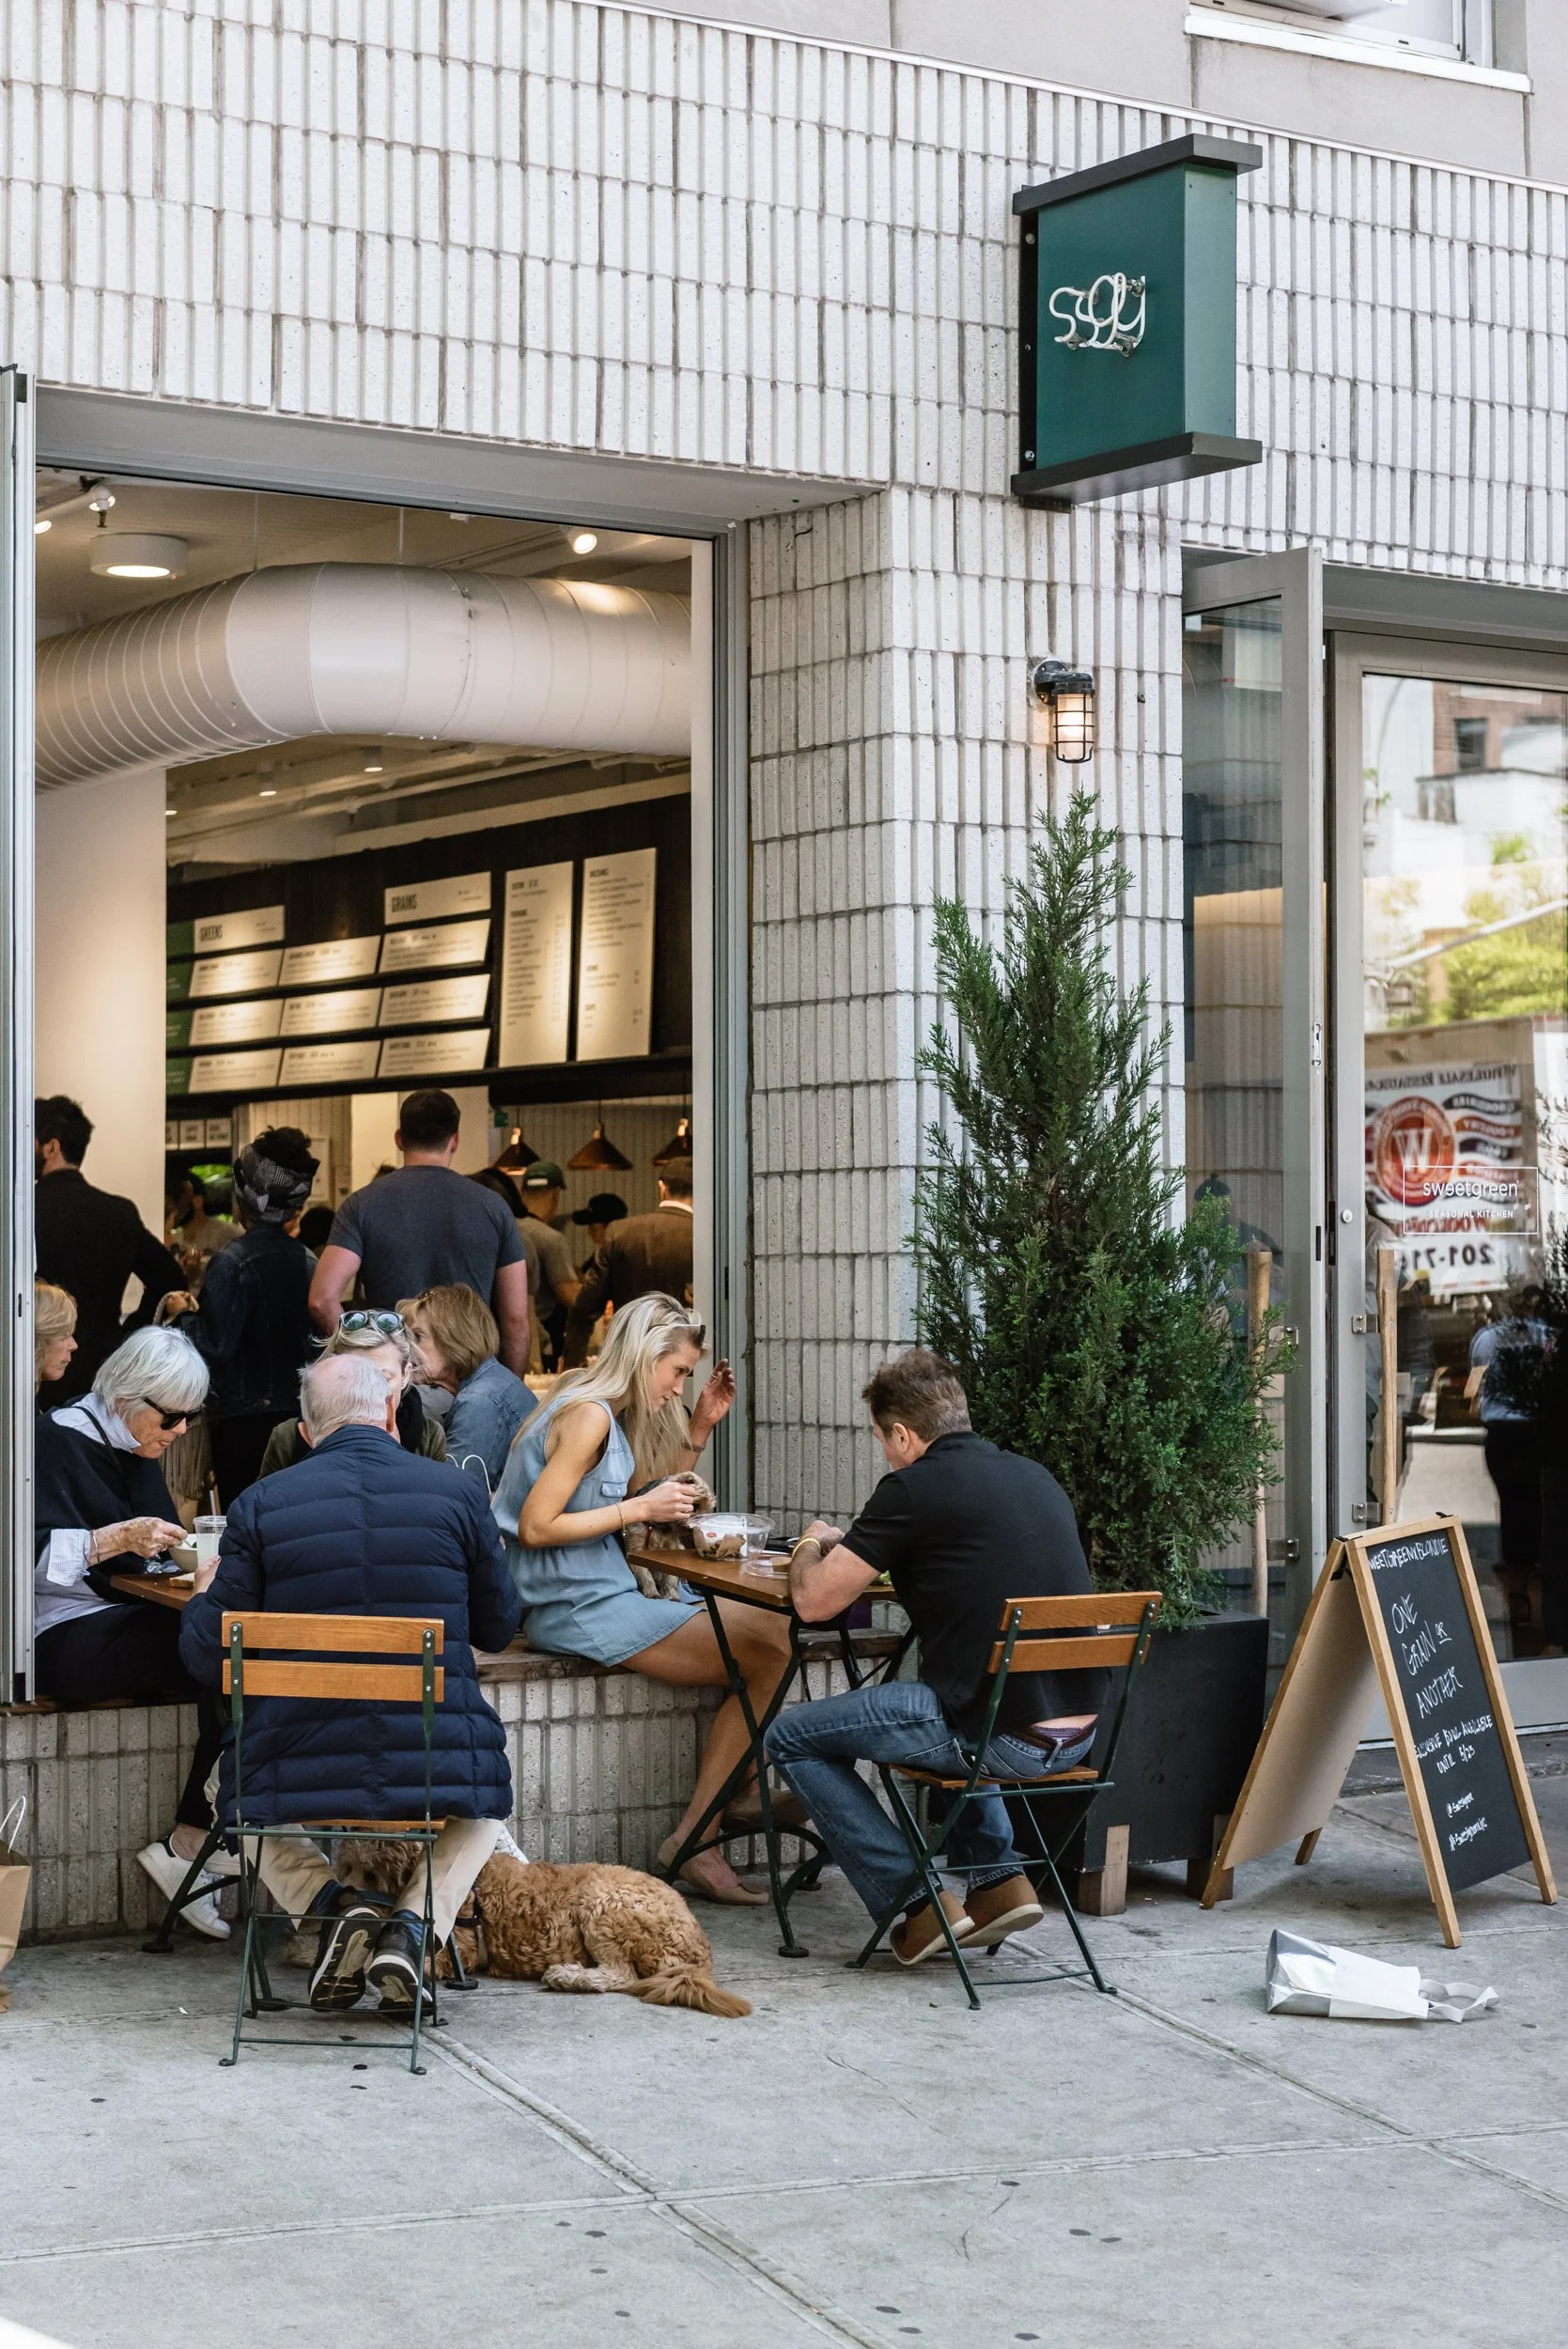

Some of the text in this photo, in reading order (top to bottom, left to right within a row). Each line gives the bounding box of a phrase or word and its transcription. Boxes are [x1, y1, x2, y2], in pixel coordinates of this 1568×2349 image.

[391, 892, 417, 912] GRAINS
[200, 924, 224, 941] GREENS
[1423, 1181, 1519, 1199] sweetgreen
[1428, 1209, 1514, 1219] SEASONAL KITCHEN
[1391, 1594, 1418, 1634] ONE
[1402, 1620, 1450, 1676] GRAIN OR
[1417, 1666, 1464, 1719] ANOTHER
[1442, 1726, 1462, 1747] BOWL
[1461, 1715, 1493, 1736] AVAILABLE
[1436, 1744, 1476, 1774] UNTIL 5/23
